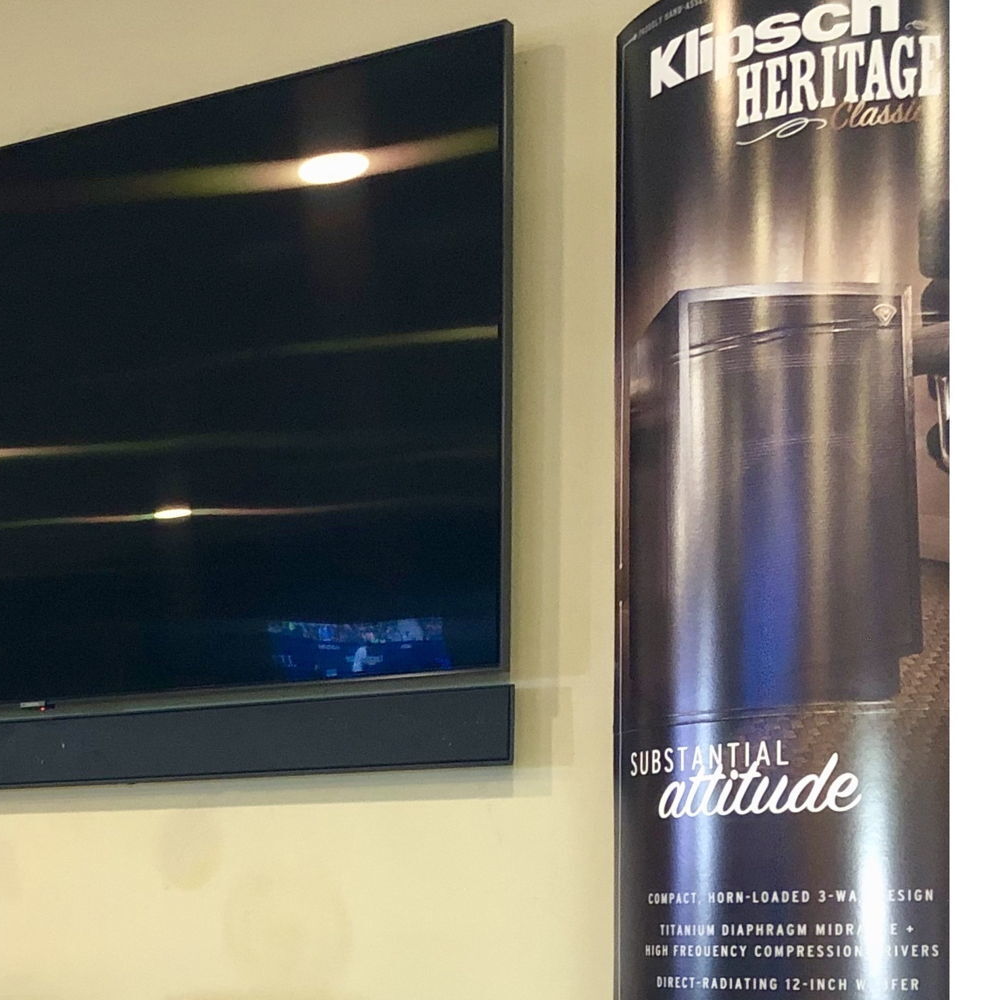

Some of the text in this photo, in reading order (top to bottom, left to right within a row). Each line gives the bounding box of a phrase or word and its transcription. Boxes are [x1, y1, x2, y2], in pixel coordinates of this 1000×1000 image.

[650, 0, 900, 98] Klipsch
[736, 34, 942, 128] HERITAGE
[630, 740, 789, 777] SUBSTANTIAL
[658, 752, 861, 819] attitude
[708, 890, 810, 904] HORN-LOADED
[818, 889, 864, 903] 3-WA
[880, 889, 935, 902] ESIGN
[660, 923, 715, 936] TITANIUM
[722, 923, 808, 936] DIAPHRAGM
[815, 923, 898, 936] MIDRE
[645, 944, 940, 958] HIGH FREQUENCY COMPRESSION RIVERS
[656, 976, 920, 992] DIRECT-RADIATING 12-INCH WFER
